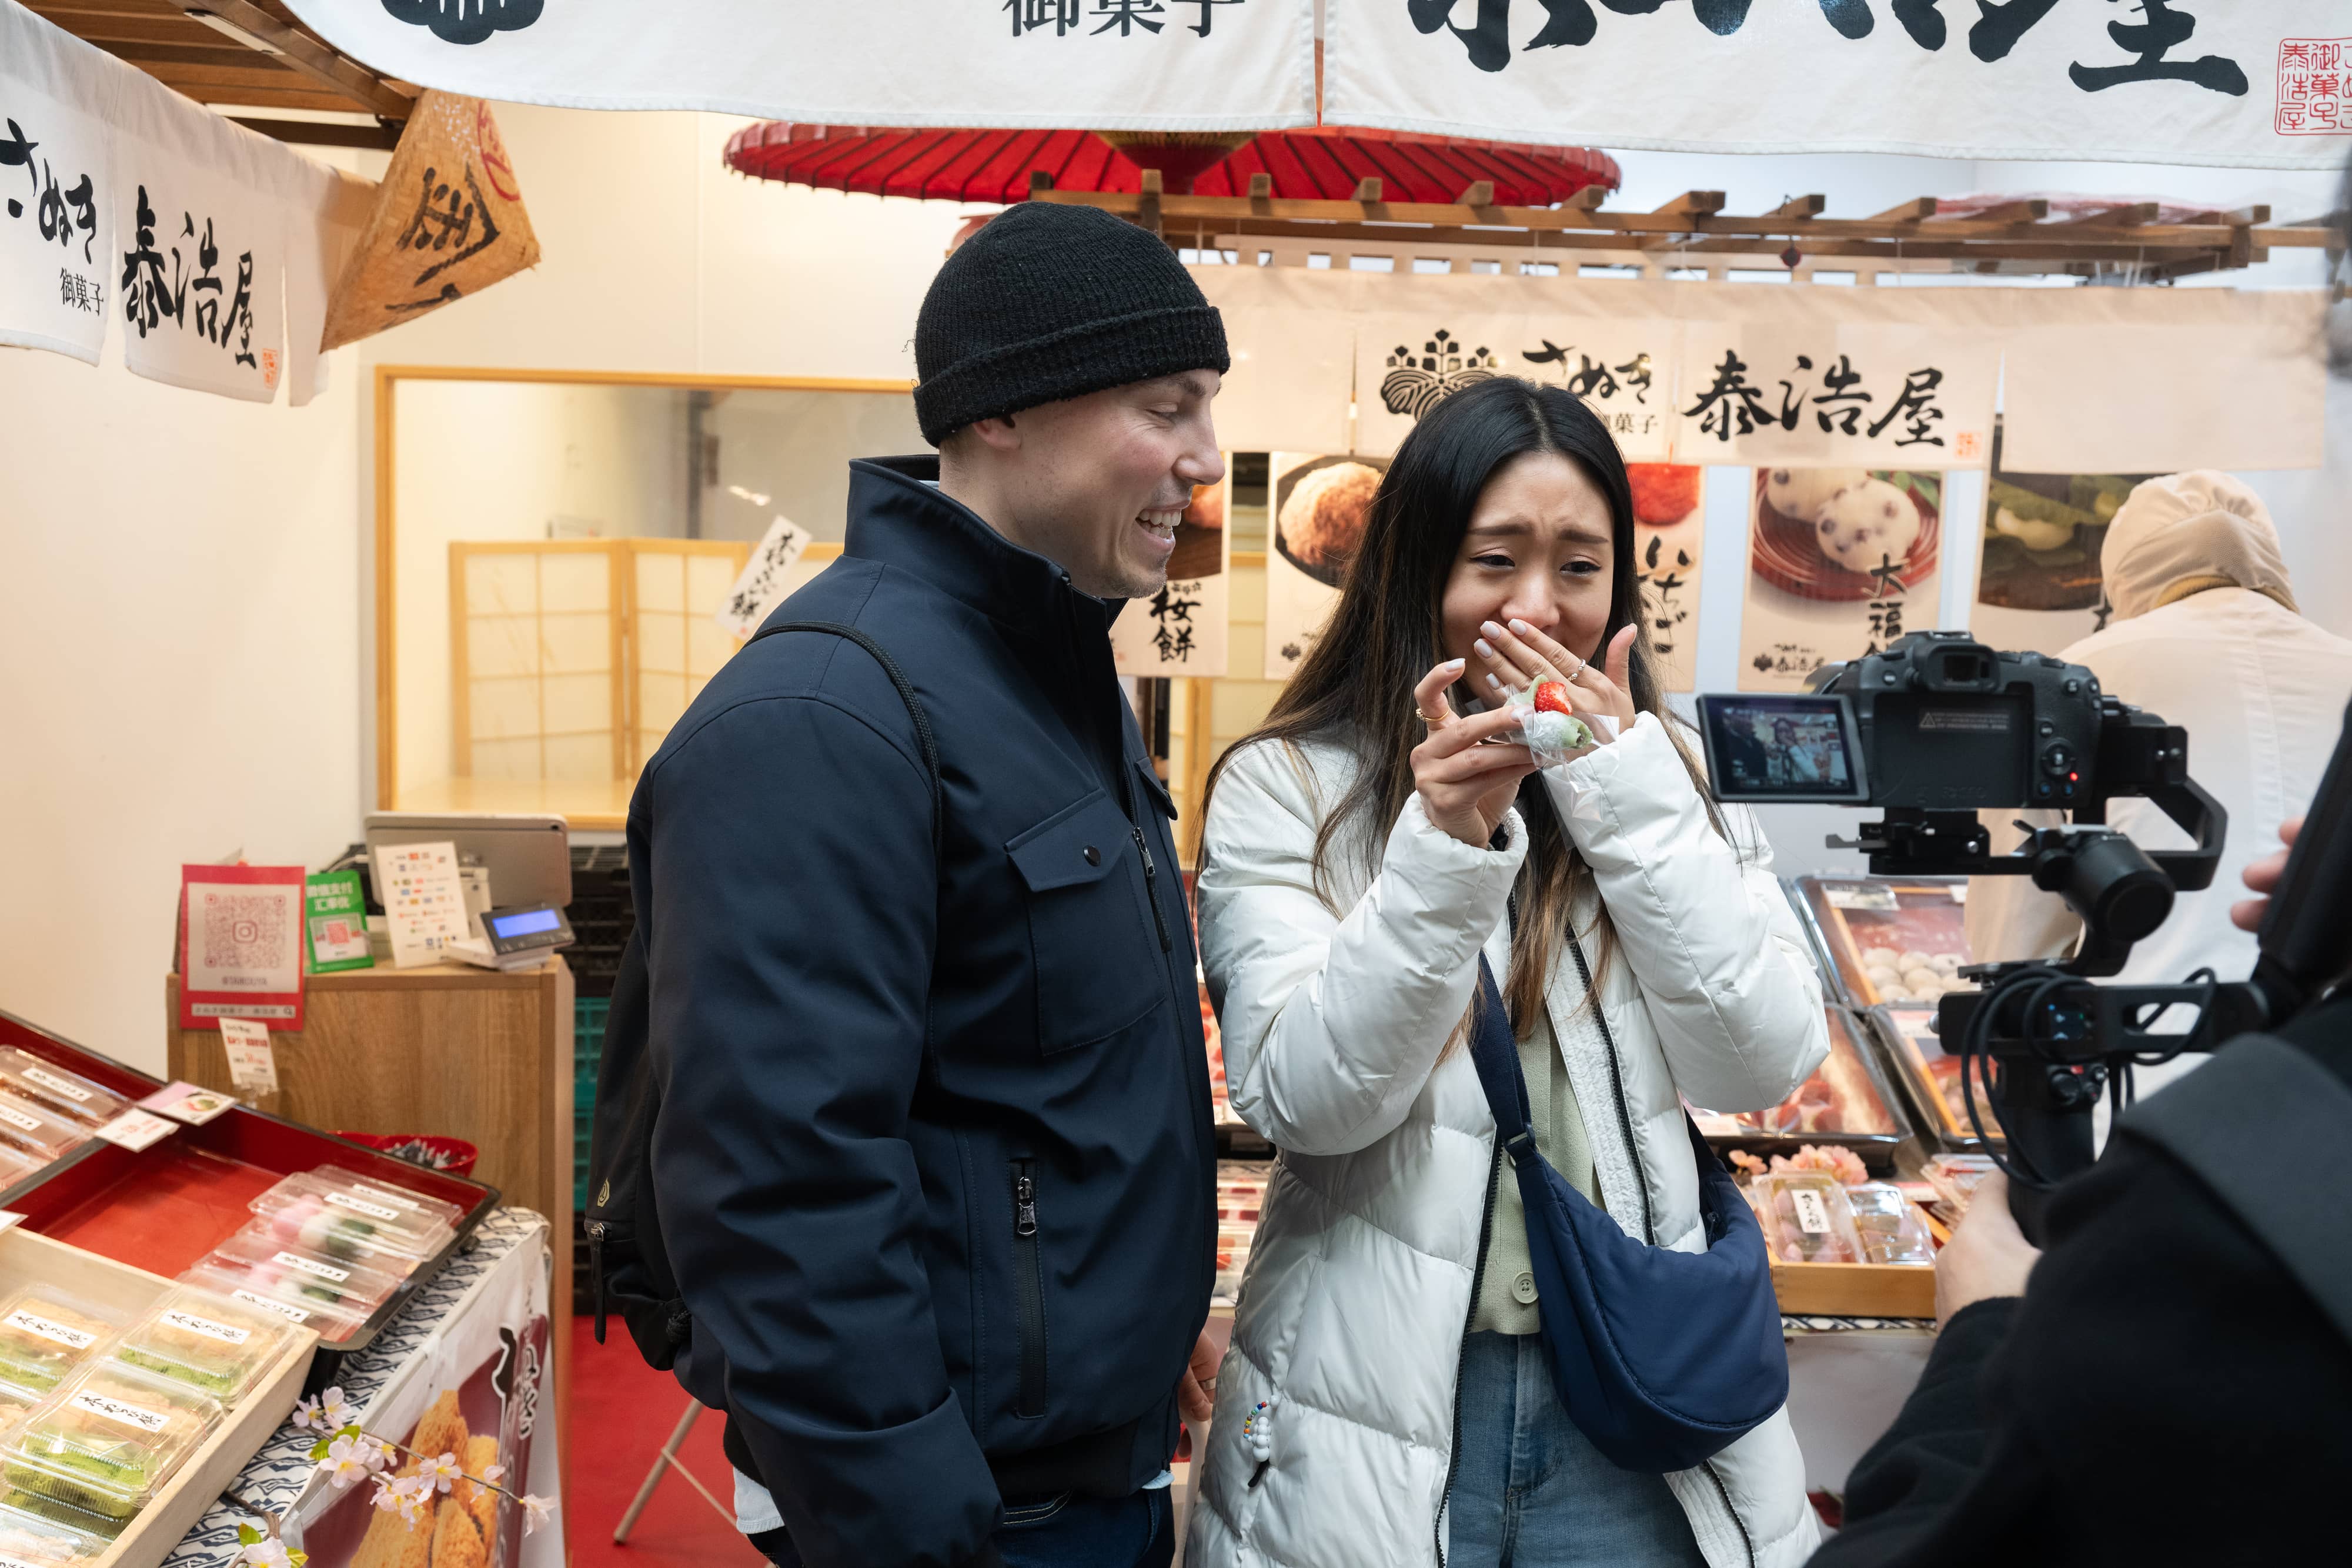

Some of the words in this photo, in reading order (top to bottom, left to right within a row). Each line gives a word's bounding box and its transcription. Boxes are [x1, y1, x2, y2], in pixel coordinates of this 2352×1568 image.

[60, 268, 104, 317] 御菓子
[122, 185, 256, 370] 泰浩屋
[1522, 339, 1652, 404] さぬき
[1681, 349, 1946, 447] 泰浩屋
[1606, 412, 1659, 434] 菓子
[1150, 581, 1202, 663] 桜餅
[1863, 553, 1906, 657] 大福
